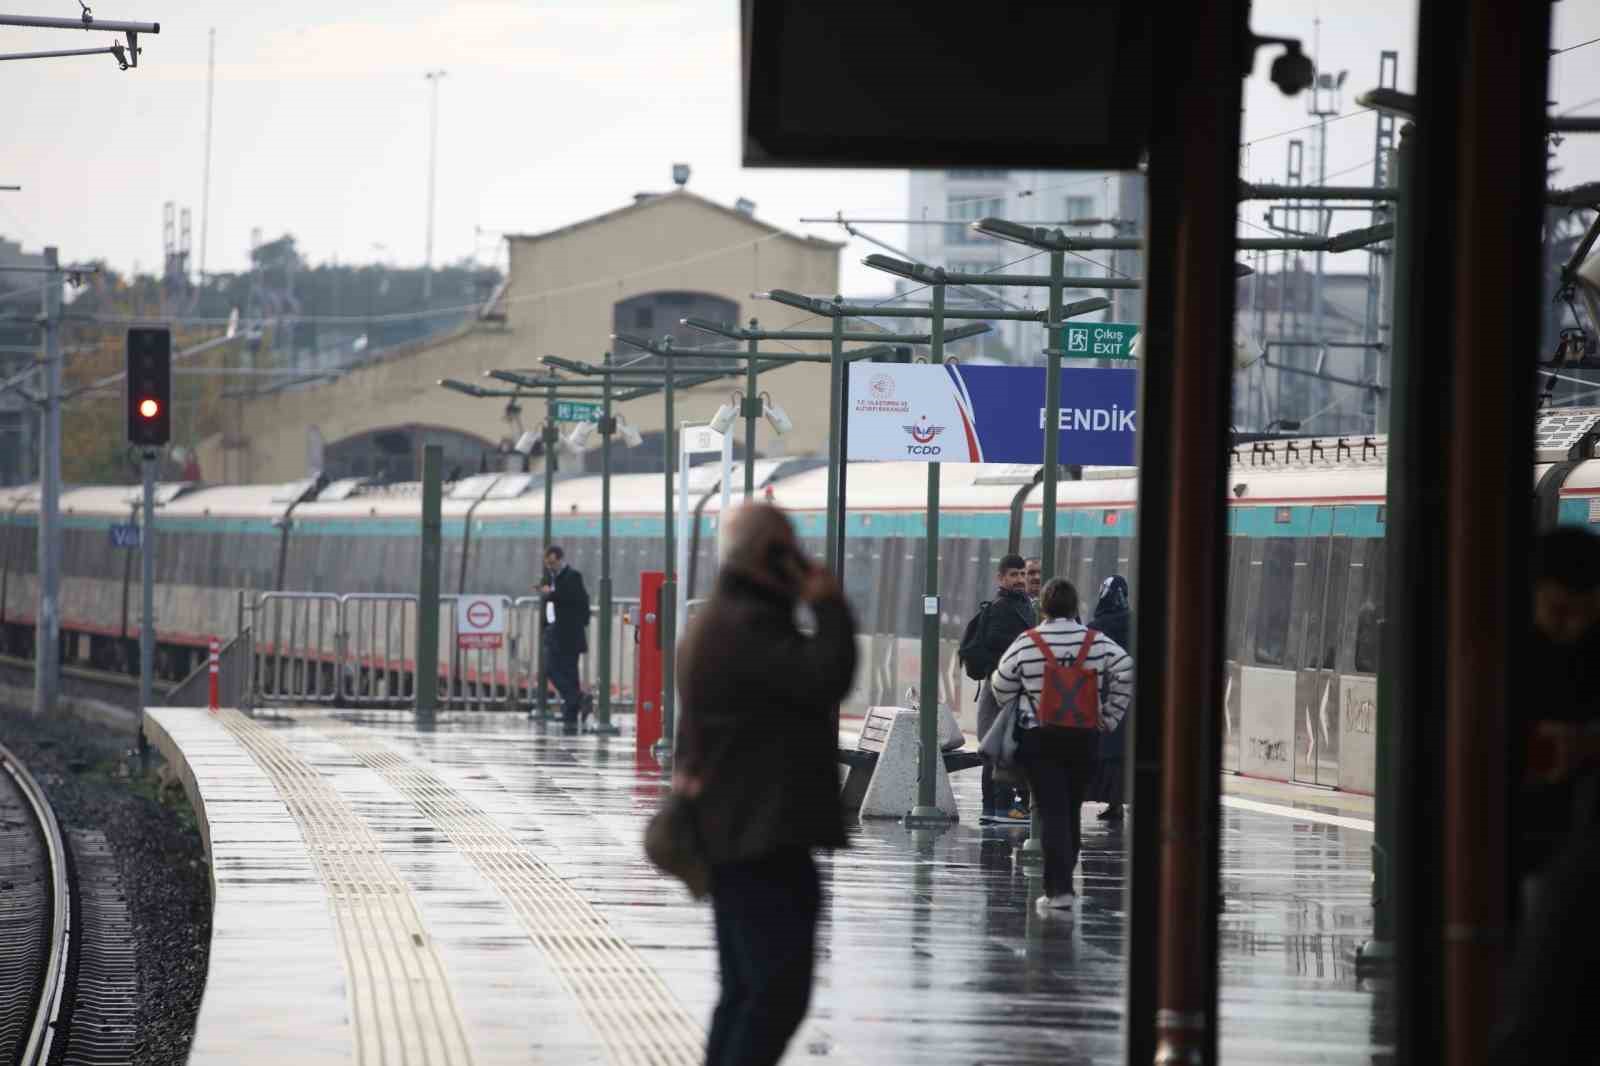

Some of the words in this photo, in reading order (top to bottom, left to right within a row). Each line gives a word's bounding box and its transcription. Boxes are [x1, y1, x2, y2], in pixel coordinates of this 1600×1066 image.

[1093, 328, 1124, 342] Çıkış
[1093, 343, 1123, 355] EXIT
[907, 445, 941, 455] TCDD
